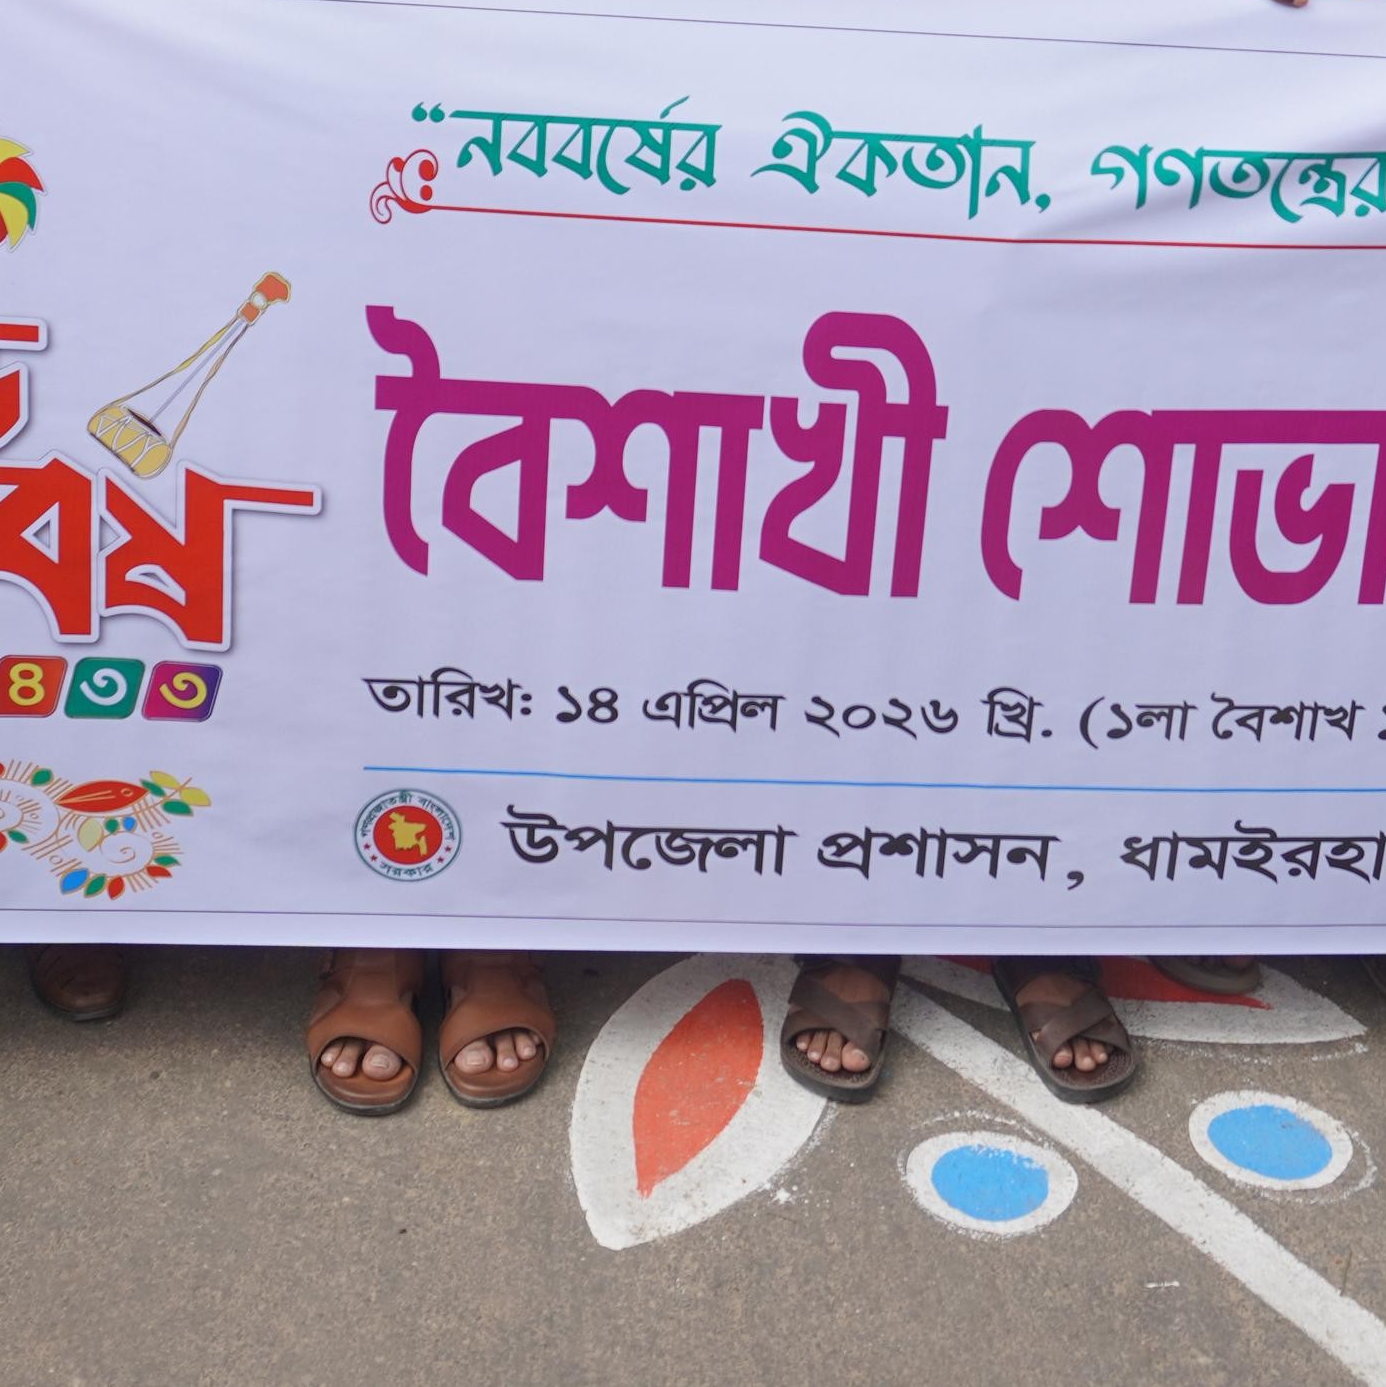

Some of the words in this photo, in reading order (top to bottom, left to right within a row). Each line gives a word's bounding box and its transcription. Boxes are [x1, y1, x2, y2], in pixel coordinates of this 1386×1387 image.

[752, 110, 1051, 220] ঐকতান,
[365, 304, 950, 598] বৈশাখী
[363, 667, 533, 720] তারিখ:
[556, 686, 619, 724] ১৪
[642, 679, 785, 732] এপ্রিল
[805, 696, 959, 739] ২০২৬
[982, 687, 1053, 743] খ্রি.
[1079, 696, 1197, 749] (১লা
[1211, 693, 1365, 742] বৈশাখ
[500, 804, 798, 876] উপজেলা
